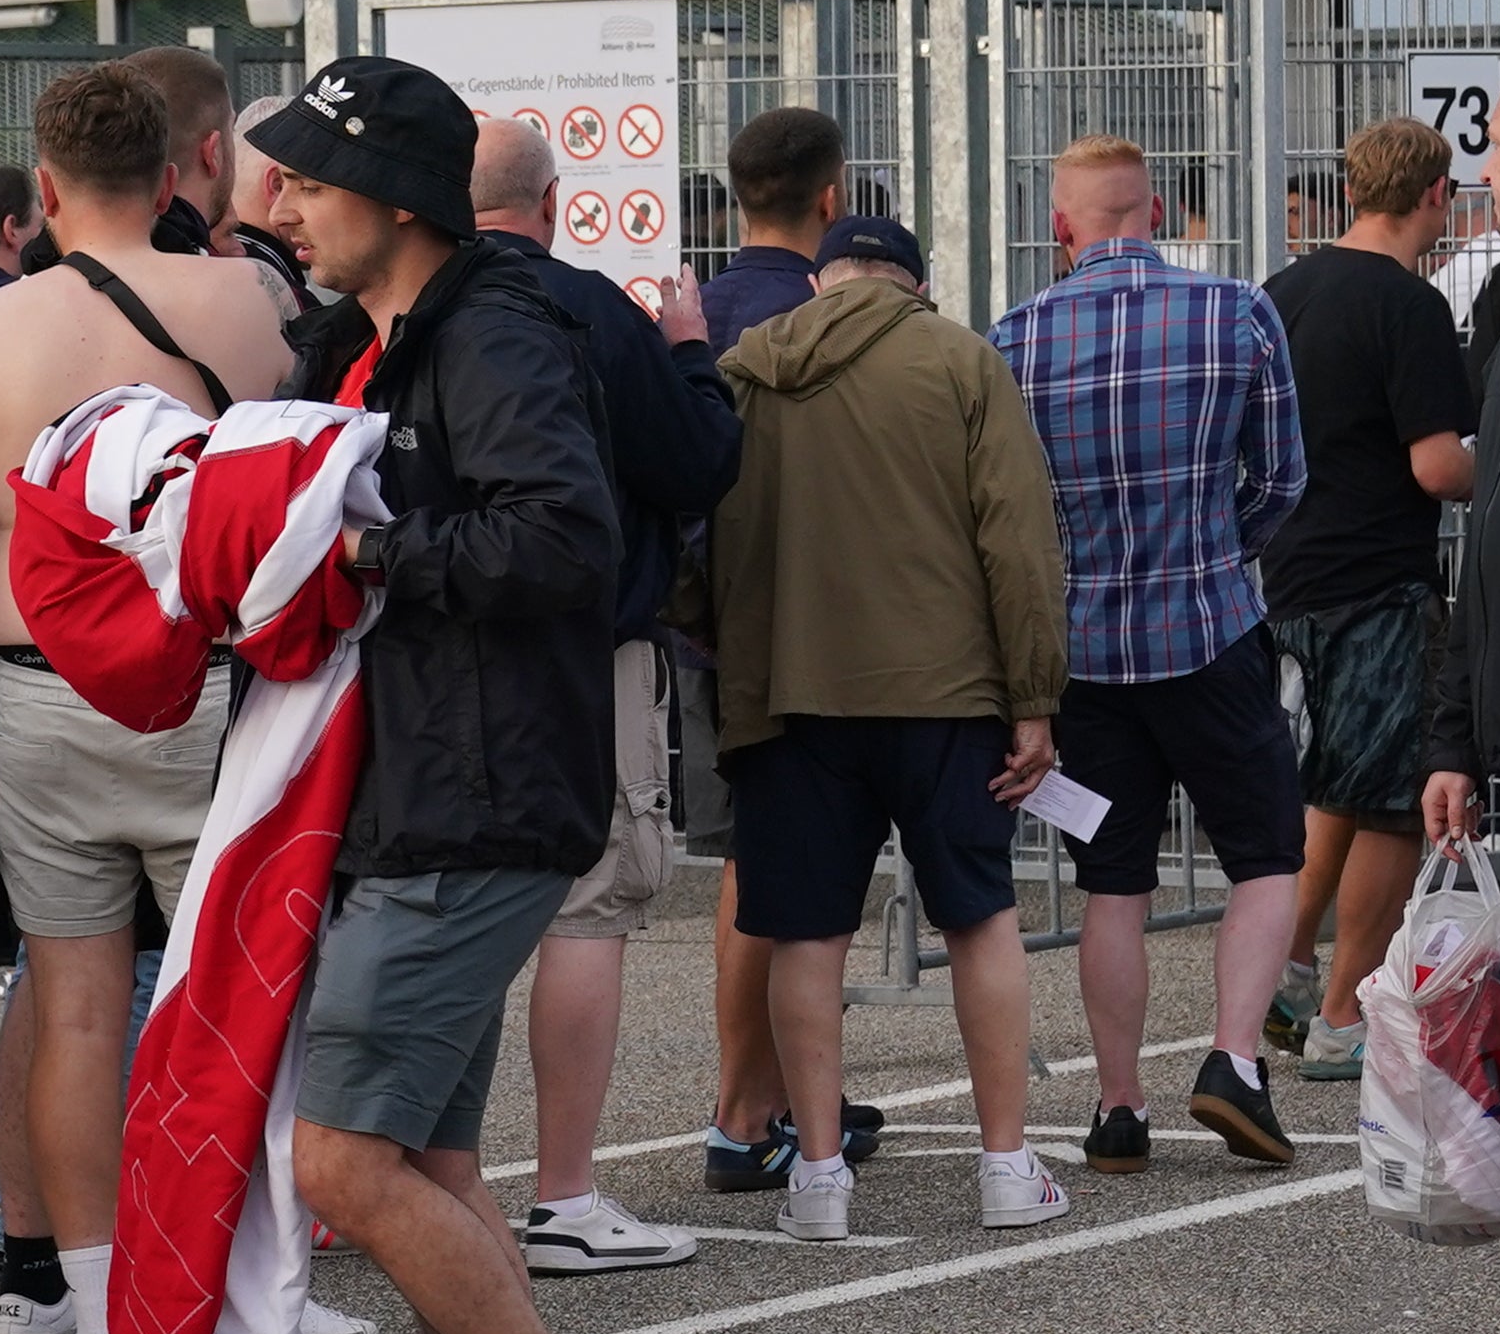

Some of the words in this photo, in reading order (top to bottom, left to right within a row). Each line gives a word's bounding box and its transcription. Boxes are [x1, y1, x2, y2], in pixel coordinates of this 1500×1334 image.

[468, 75, 545, 96] Gegenstände
[557, 72, 619, 90] Prohibited
[622, 73, 655, 87] Items
[303, 93, 338, 120] adidas
[1422, 86, 1490, 156] 73
